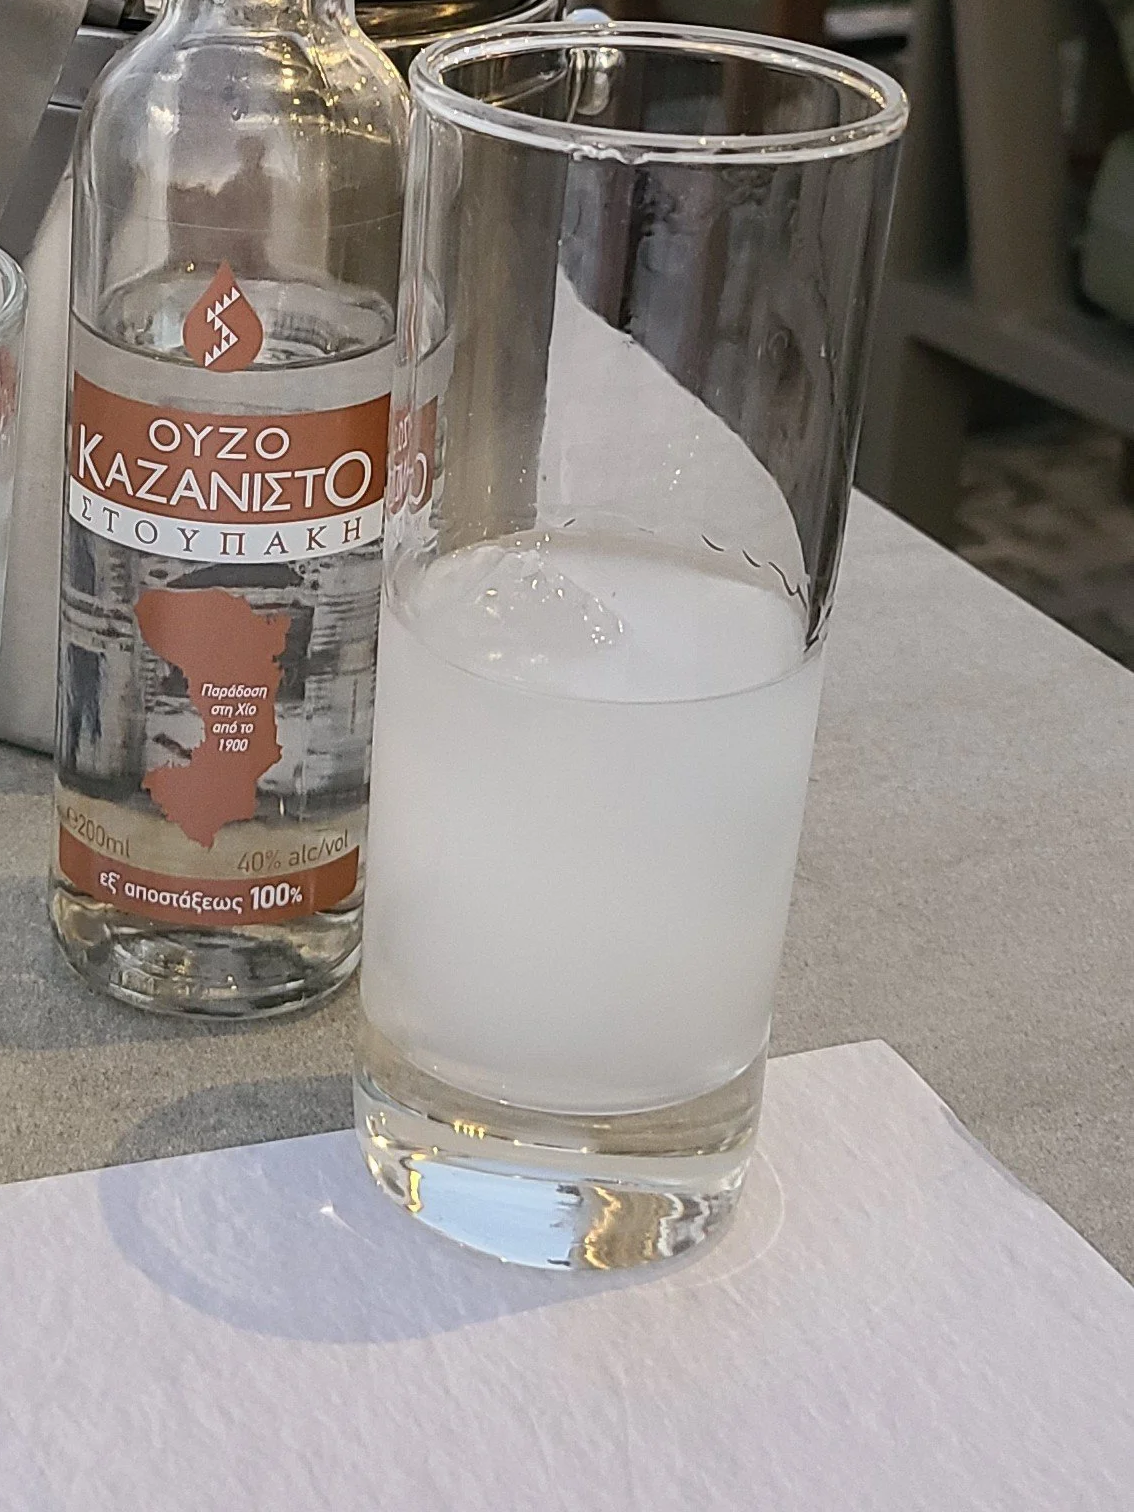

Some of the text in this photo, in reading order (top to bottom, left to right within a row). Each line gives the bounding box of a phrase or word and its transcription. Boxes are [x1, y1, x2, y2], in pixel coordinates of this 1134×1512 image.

[149, 419, 290, 460] ΟΥΖΟ
[78, 424, 372, 512] ΚΑΖΑΝΙΣΤΟ
[81, 495, 363, 555] ΣΤΟΥΠΑΚΗ
[201, 684, 267, 700] Παράδοση
[211, 703, 257, 718] στη Χίο
[213, 721, 253, 734] από το
[219, 739, 248, 751] 1900
[237, 829, 349, 873] 40% alc/vol
[124, 880, 244, 915] αποστάξεως
[249, 882, 303, 909] 100%
